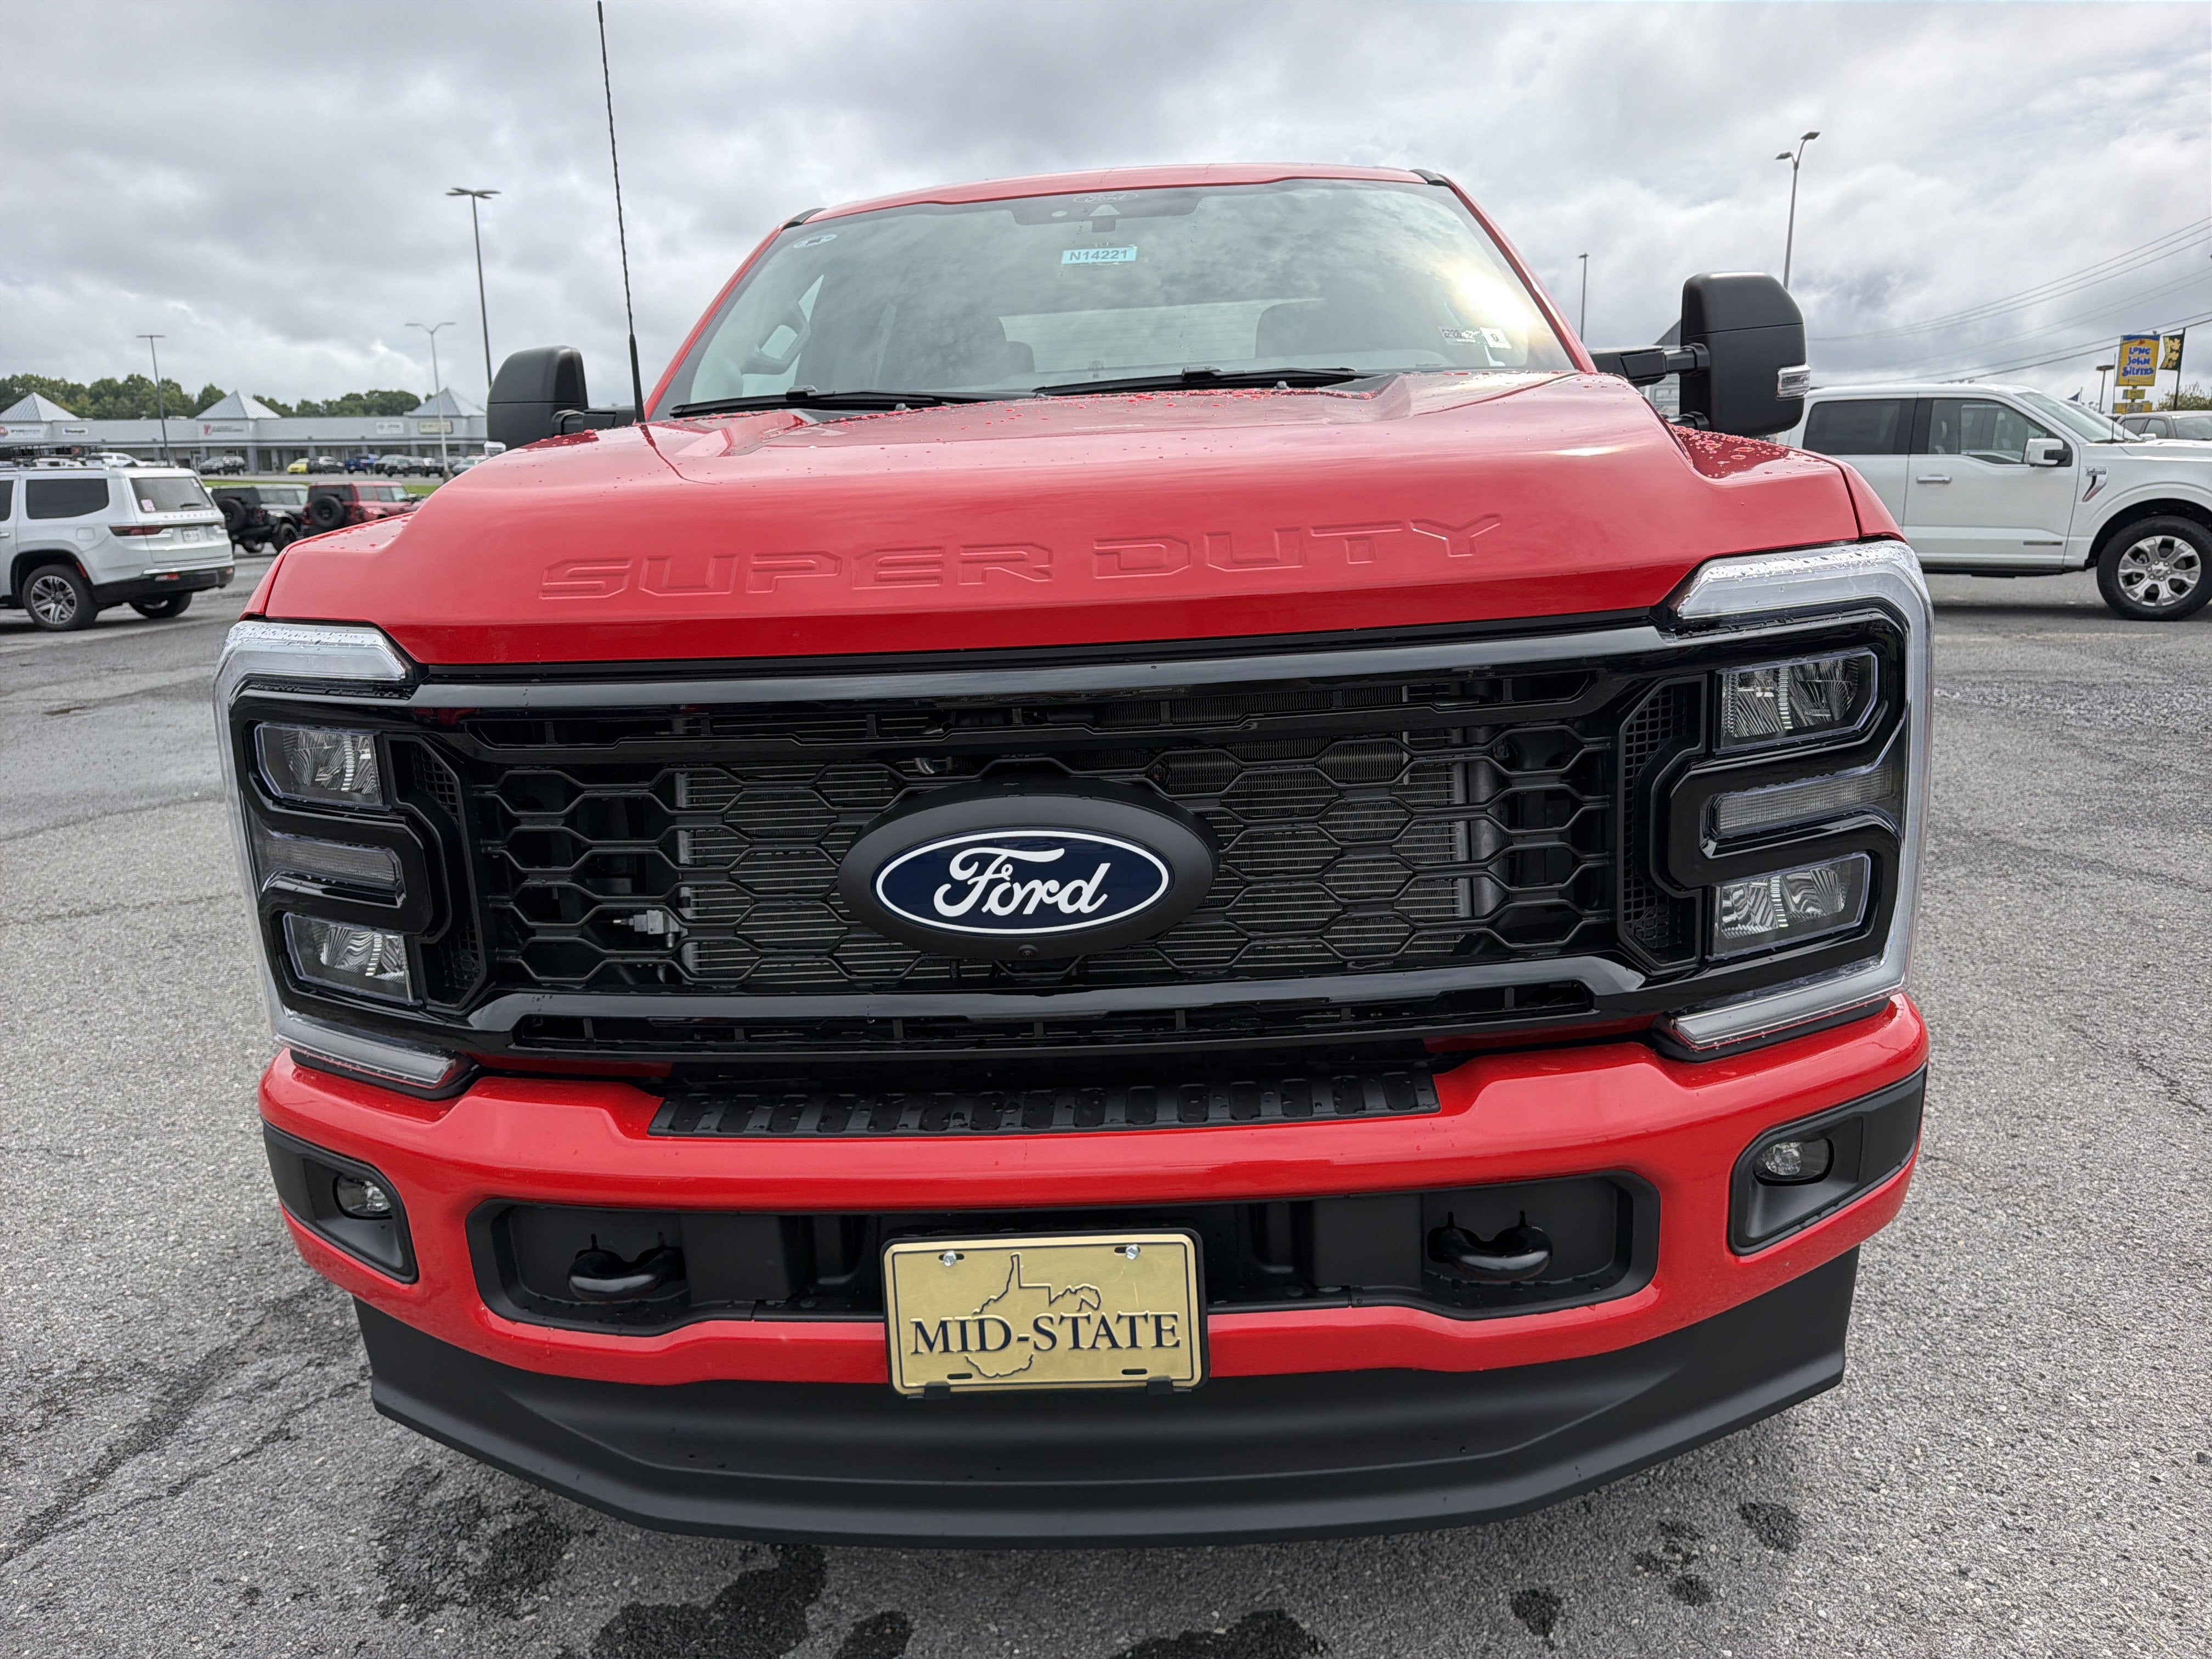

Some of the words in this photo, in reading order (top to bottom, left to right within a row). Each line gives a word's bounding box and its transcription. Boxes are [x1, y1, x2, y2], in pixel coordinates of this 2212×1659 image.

[1085, 193, 1127, 202] Ford
[1069, 249, 1128, 261] N14221
[538, 542, 1053, 600] SUPER
[1093, 513, 1503, 579] DUTY
[933, 847, 1111, 917] Ford
[910, 1310, 1182, 1356] MID-STATE
